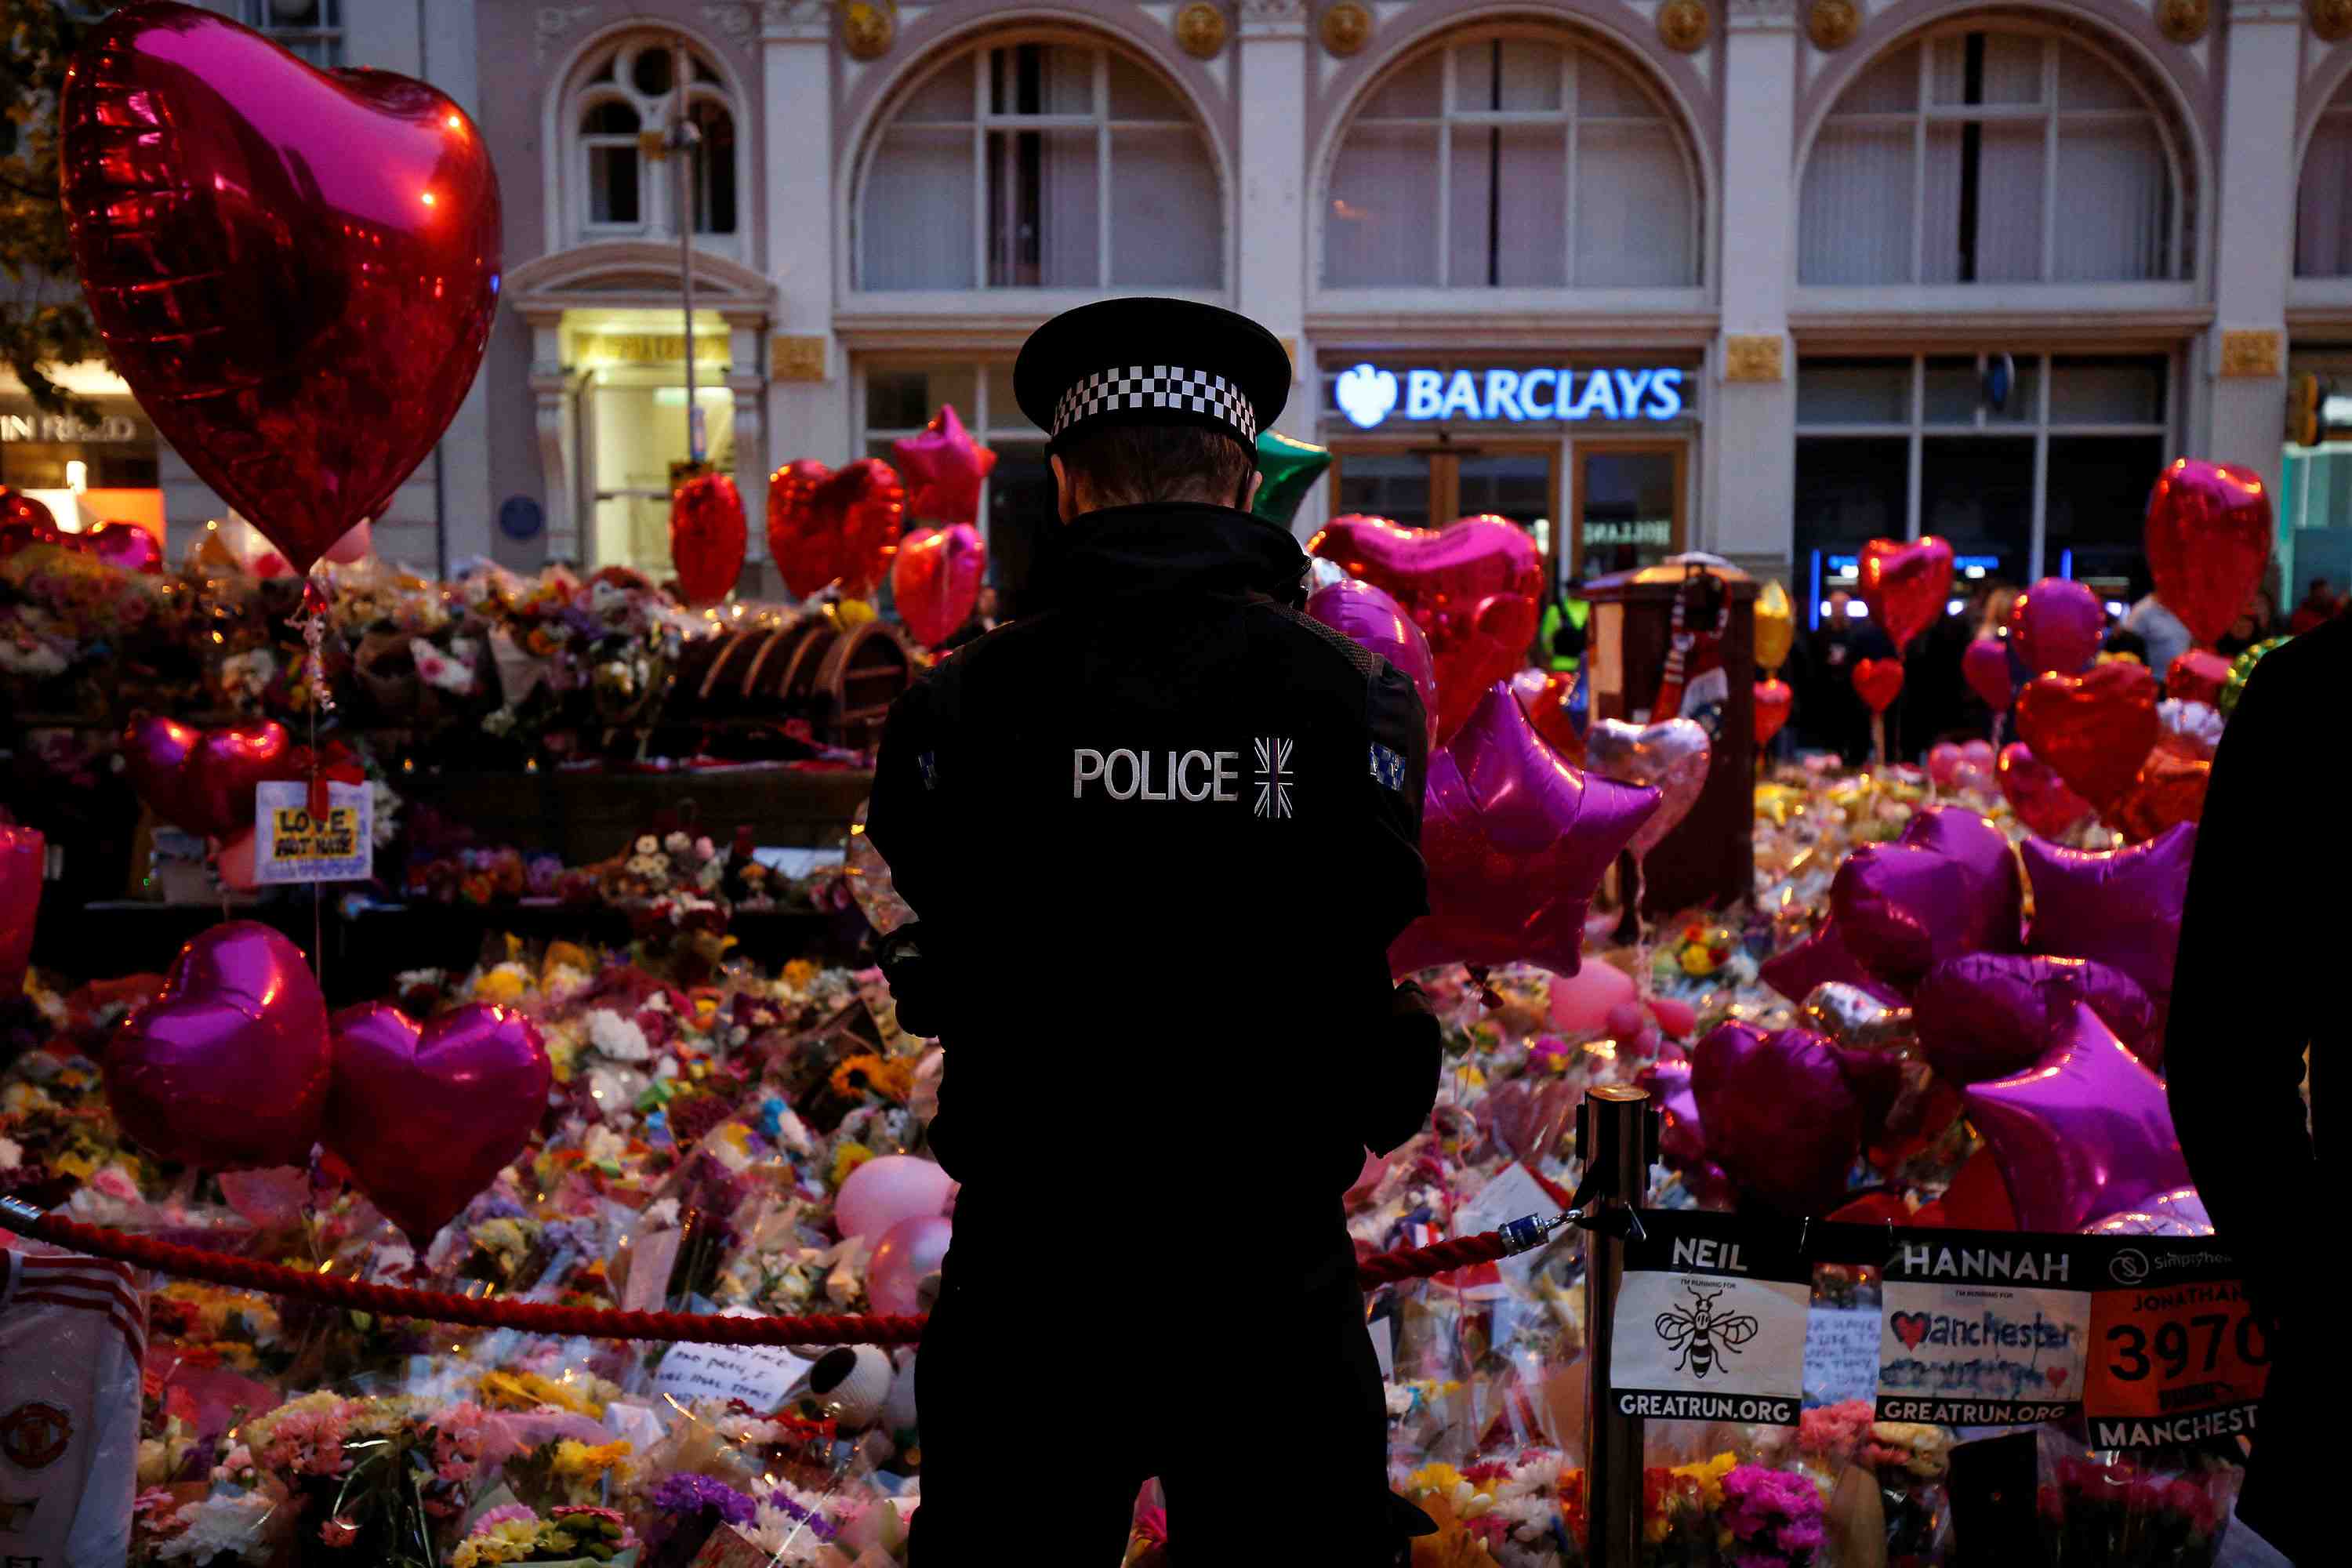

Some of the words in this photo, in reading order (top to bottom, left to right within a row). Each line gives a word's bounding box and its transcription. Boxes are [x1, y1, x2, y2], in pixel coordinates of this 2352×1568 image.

[1407, 368, 1682, 420] BARCLAYS
[42, 413, 137, 443] RED
[1073, 748, 1240, 802] POLICE
[1671, 1236, 1748, 1272] NEIL
[1904, 1244, 2070, 1283] HANNAH
[1691, 1279, 1722, 1288] RUNNING
[2132, 1285, 2241, 1312] JONATHAN
[2107, 1315, 2271, 1381] 3970
[1620, 1394, 1791, 1421] GREATRUN.ORG
[1884, 1400, 2066, 1425] GREATRUN.ORG
